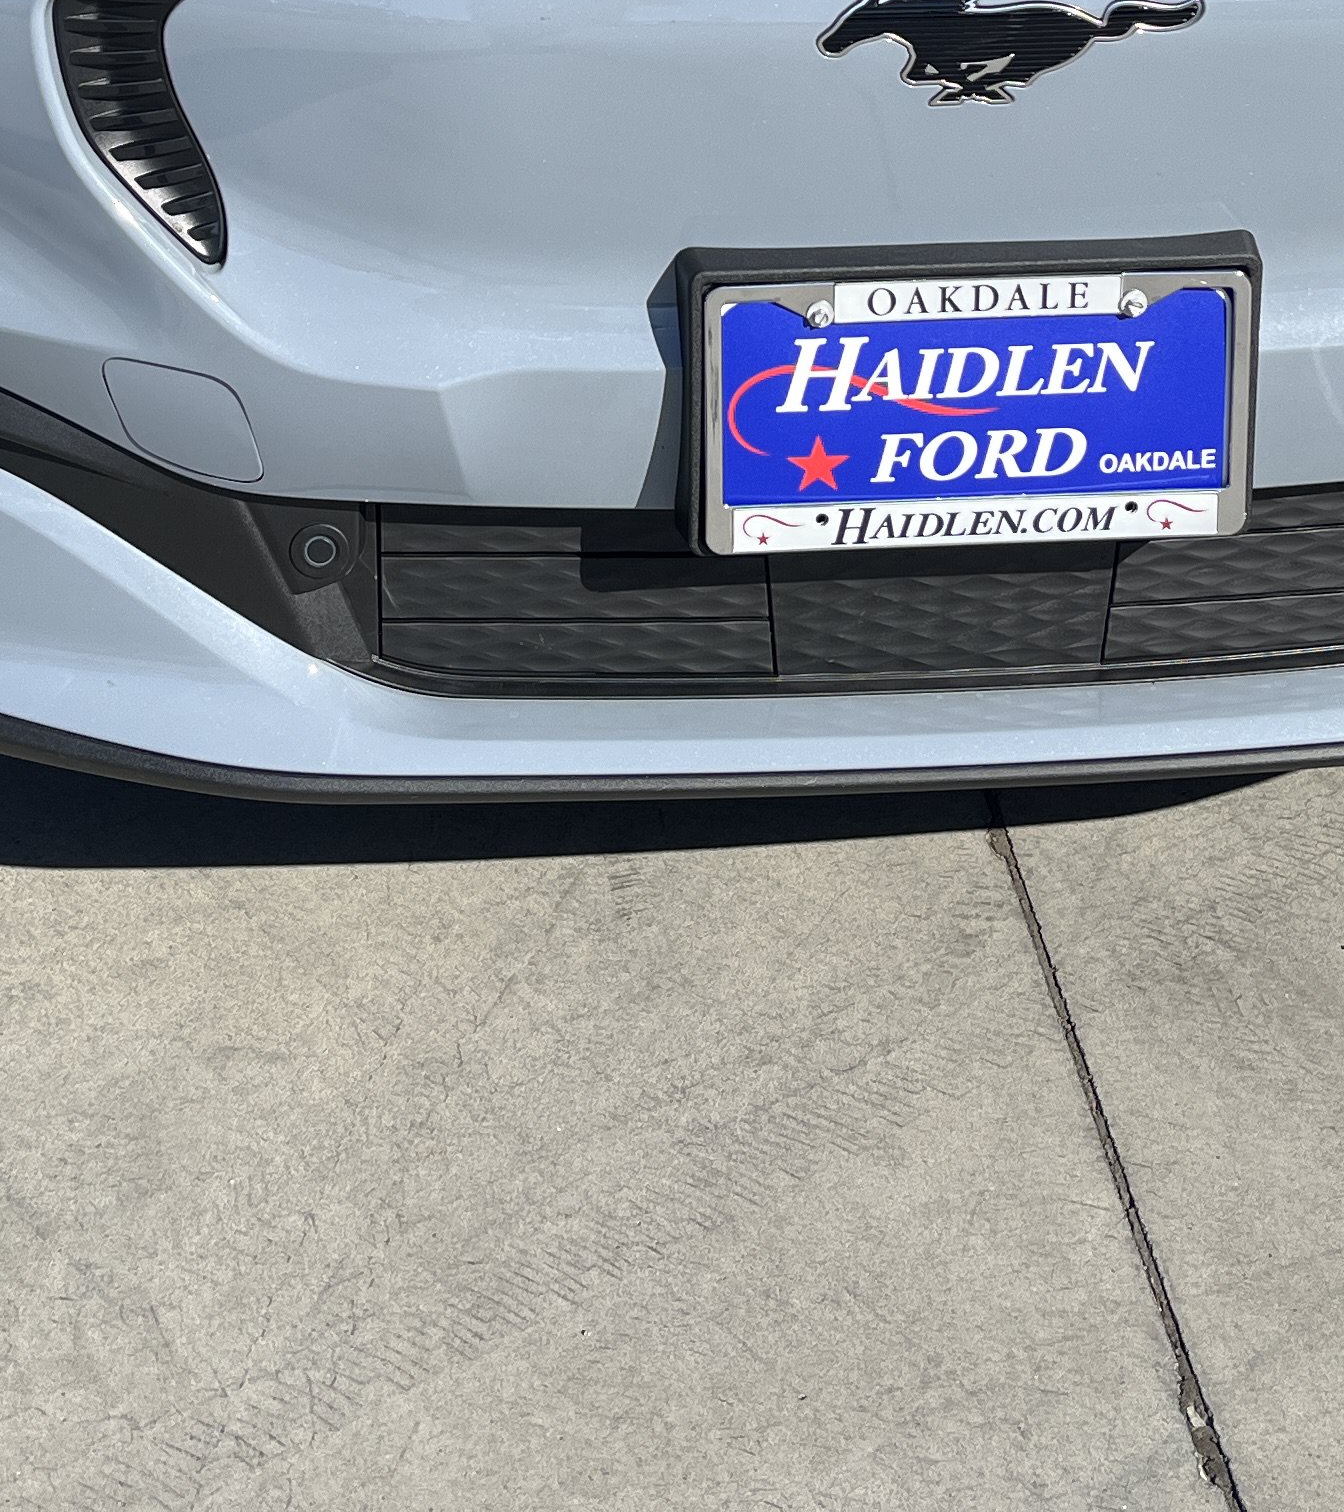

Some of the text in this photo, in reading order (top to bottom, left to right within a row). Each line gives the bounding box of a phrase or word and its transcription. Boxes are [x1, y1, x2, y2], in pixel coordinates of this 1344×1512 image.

[867, 282, 1090, 316] OAKDALE
[775, 336, 1155, 413] HAIDLEN
[870, 427, 1217, 483] FORD OAKDALE
[831, 506, 1116, 546] HAIDLEN.COM
